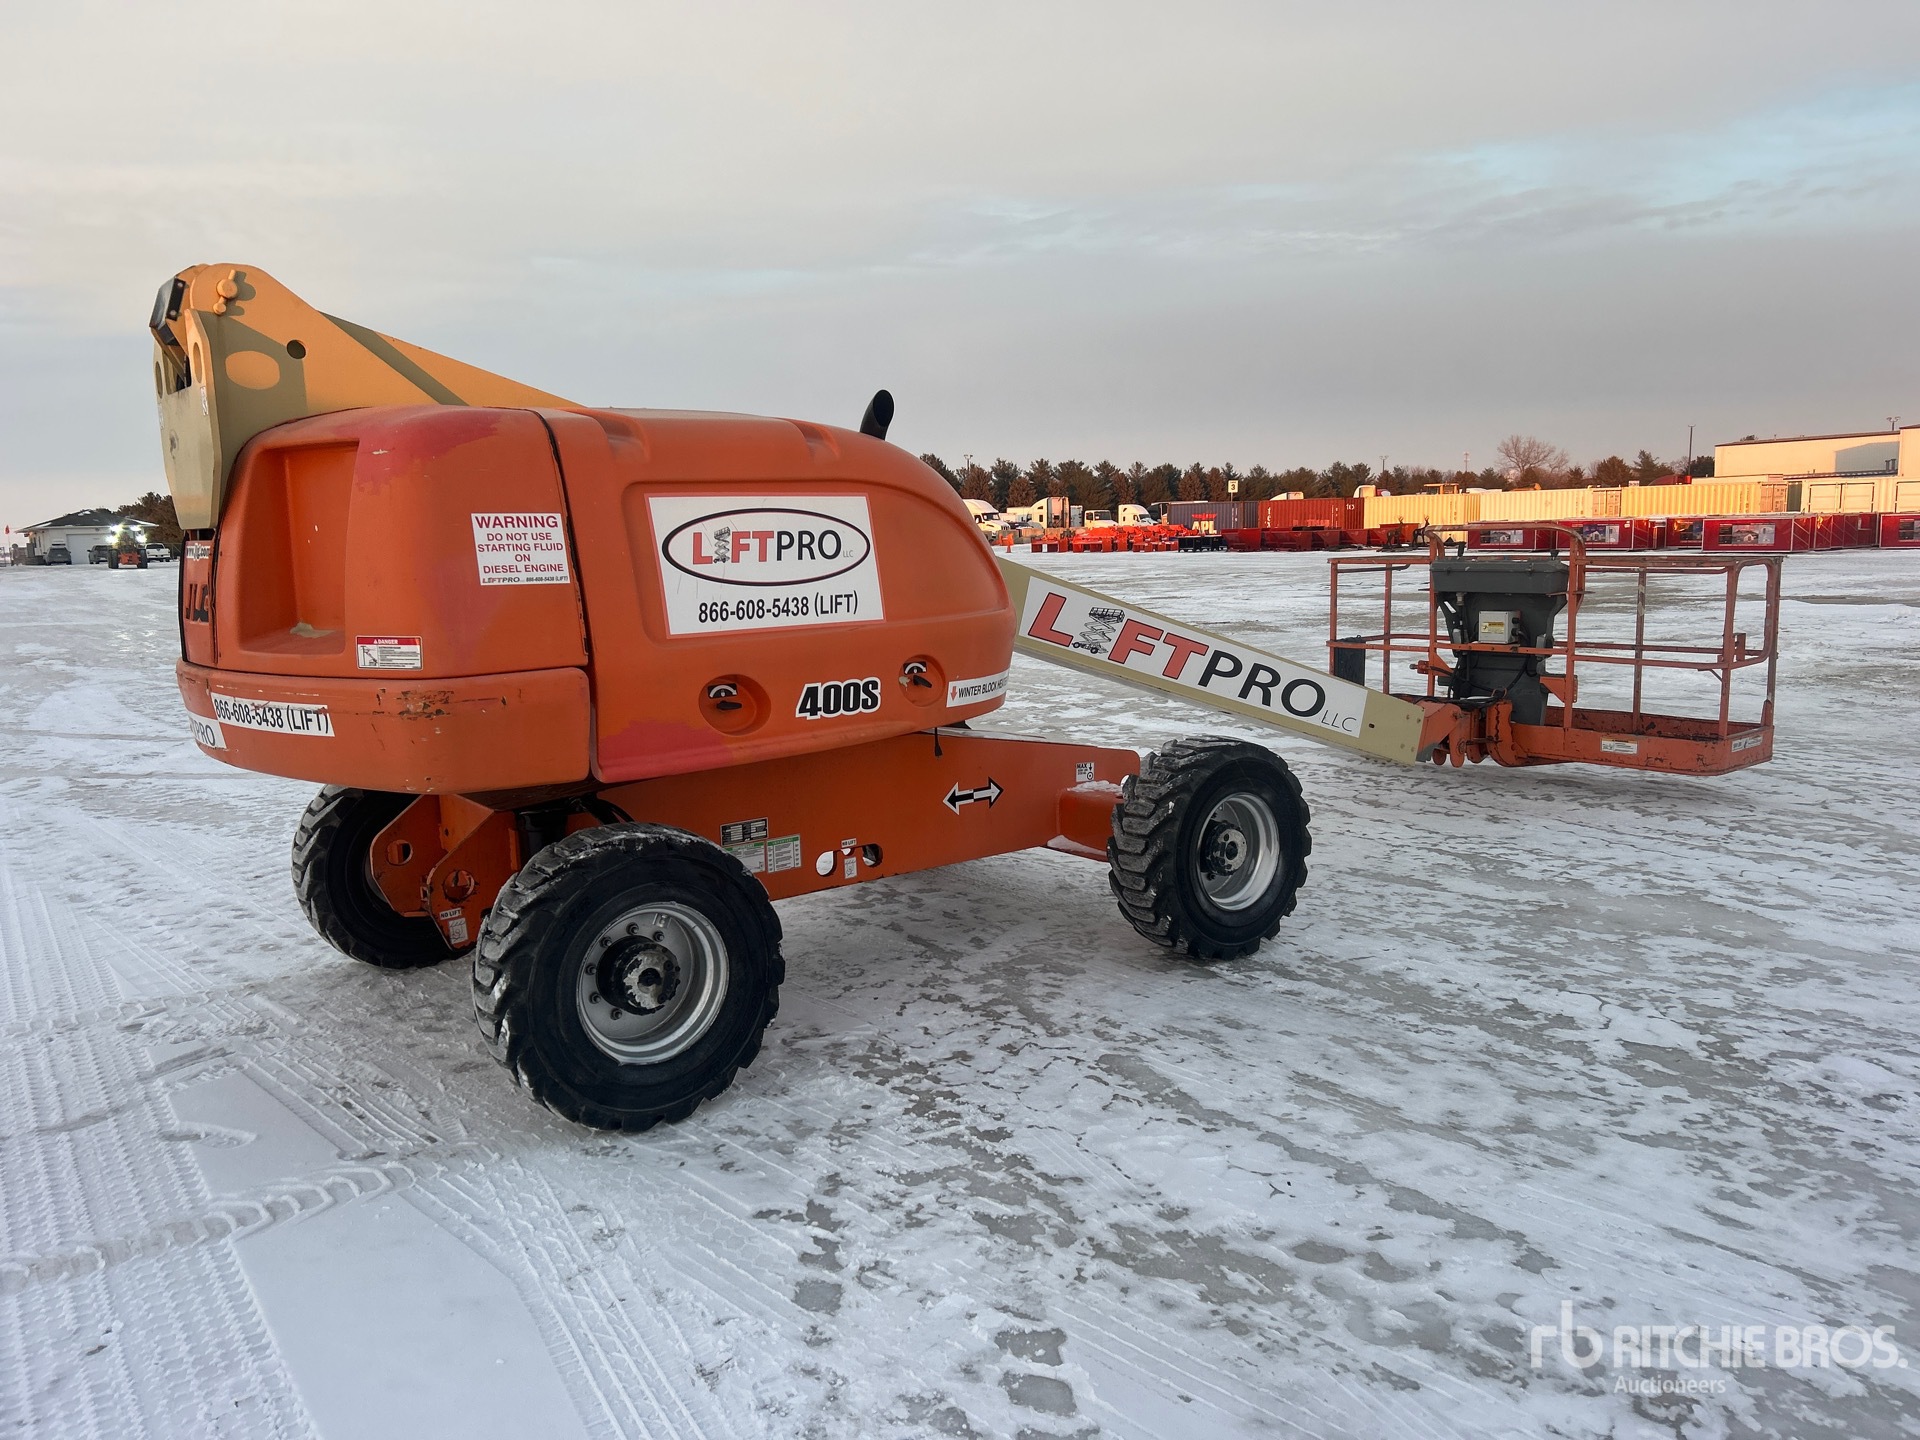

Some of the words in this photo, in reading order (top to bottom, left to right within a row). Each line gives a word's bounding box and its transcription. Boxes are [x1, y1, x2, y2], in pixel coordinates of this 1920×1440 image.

[474, 515, 558, 529] WARNING
[487, 533, 503, 542] DO
[506, 532, 528, 541] NOT
[531, 532, 552, 541] USE
[477, 543, 531, 553] STARTING
[534, 542, 564, 552] FLUID
[514, 553, 531, 562] ON
[483, 564, 523, 574] DIESEL
[524, 563, 564, 573] ENGINE
[698, 596, 810, 623] 866-608-5438
[814, 590, 859, 617] (LIFT)
[958, 685, 982, 698] WINTER
[982, 681, 998, 694] BLOCK
[797, 678, 880, 718] 400S
[214, 698, 284, 728] 866-608-5438
[287, 704, 329, 734] (LIFT)
[1321, 708, 1357, 732] LLC
